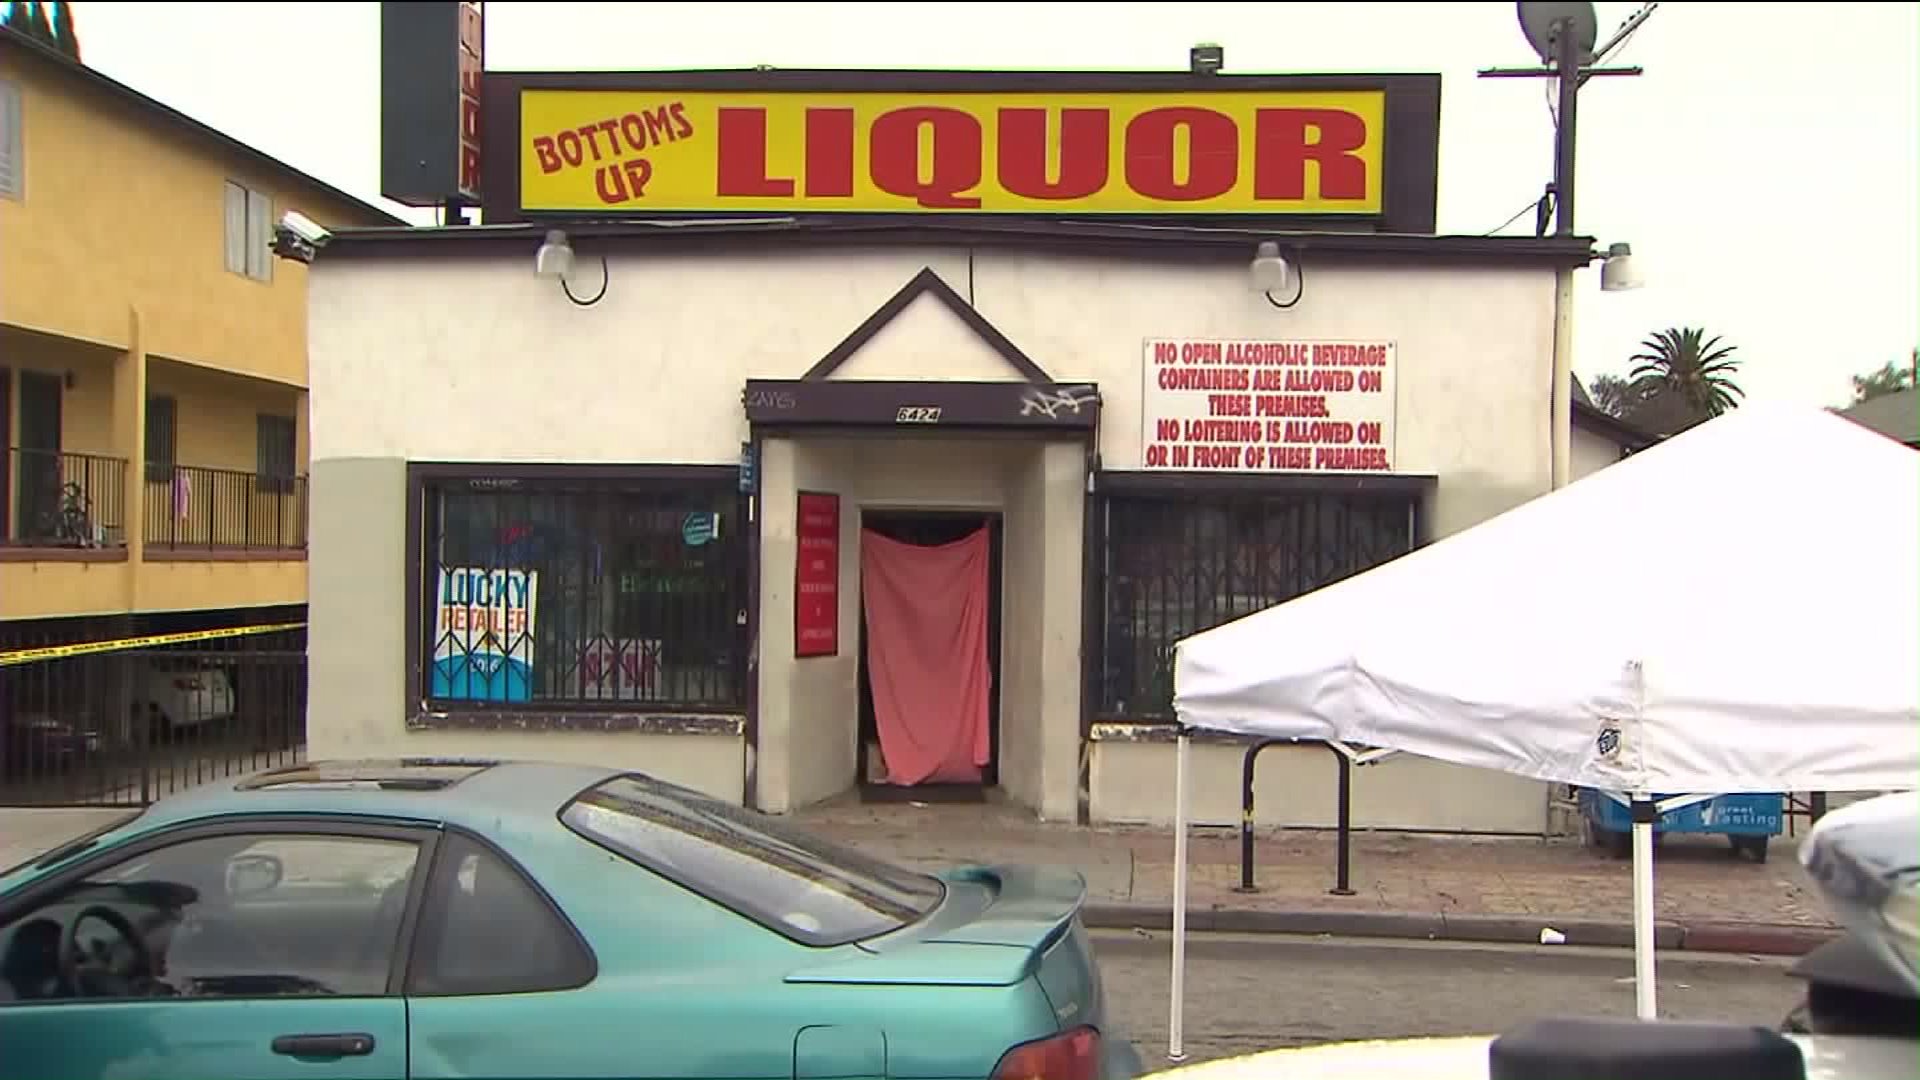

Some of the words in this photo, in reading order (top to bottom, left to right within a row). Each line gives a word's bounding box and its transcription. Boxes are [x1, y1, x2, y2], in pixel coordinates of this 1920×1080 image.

[533, 102, 694, 174] BOTTOMS
[717, 106, 1366, 209] LIQUOR
[595, 158, 653, 204] UP
[1154, 343, 1177, 364] NO
[1182, 343, 1222, 365] OPEN
[1225, 344, 1308, 366] ALCOHOLIC
[1312, 345, 1386, 366] BEVERAGE
[1158, 368, 1249, 390] CONTAINERS
[1253, 370, 1281, 391] ARE
[1285, 370, 1354, 392] ALLOWED
[1358, 371, 1381, 392] ON
[898, 408, 940, 421] 6424
[1208, 395, 1251, 416] THESE
[1255, 396, 1330, 418] PREMISES.
[1157, 419, 1179, 441] NO
[1184, 420, 1262, 443] LOITERING
[1266, 421, 1281, 443] IS
[1284, 422, 1353, 443] ALLOWED
[1357, 422, 1381, 444] ON
[1146, 446, 1168, 468] OR
[1172, 446, 1189, 468] IN
[1193, 447, 1240, 468] FRONT
[1245, 447, 1265, 469] OF
[1268, 447, 1312, 469] THESE
[1315, 448, 1391, 471] PREMISES.
[444, 574, 527, 609] LUCKY
[441, 608, 527, 633] RETAILER
